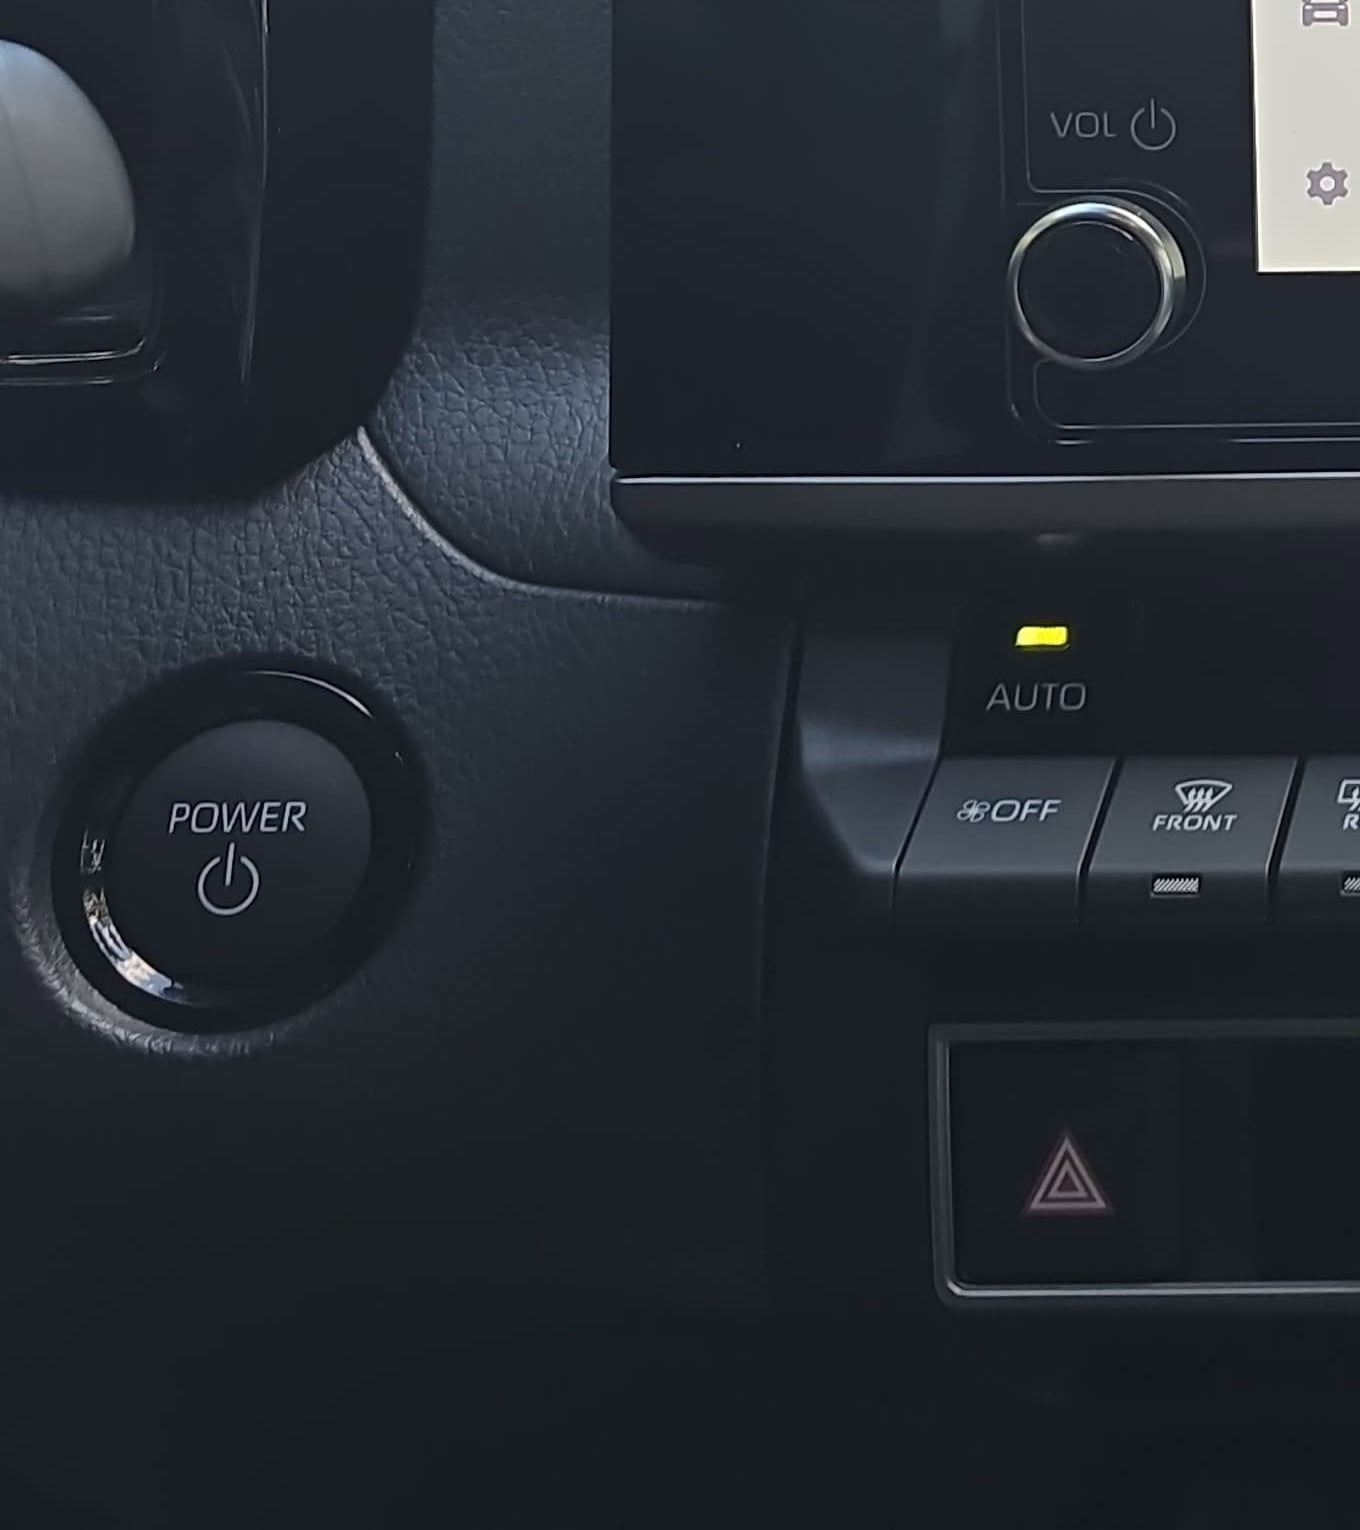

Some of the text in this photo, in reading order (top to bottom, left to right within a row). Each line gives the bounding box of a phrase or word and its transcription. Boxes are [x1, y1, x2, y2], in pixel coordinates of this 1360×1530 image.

[1050, 111, 1118, 139] VOL
[985, 682, 1088, 713] AUTO
[168, 801, 308, 834] POWER
[991, 798, 1061, 824] OFF
[1151, 813, 1238, 832] FRONT
